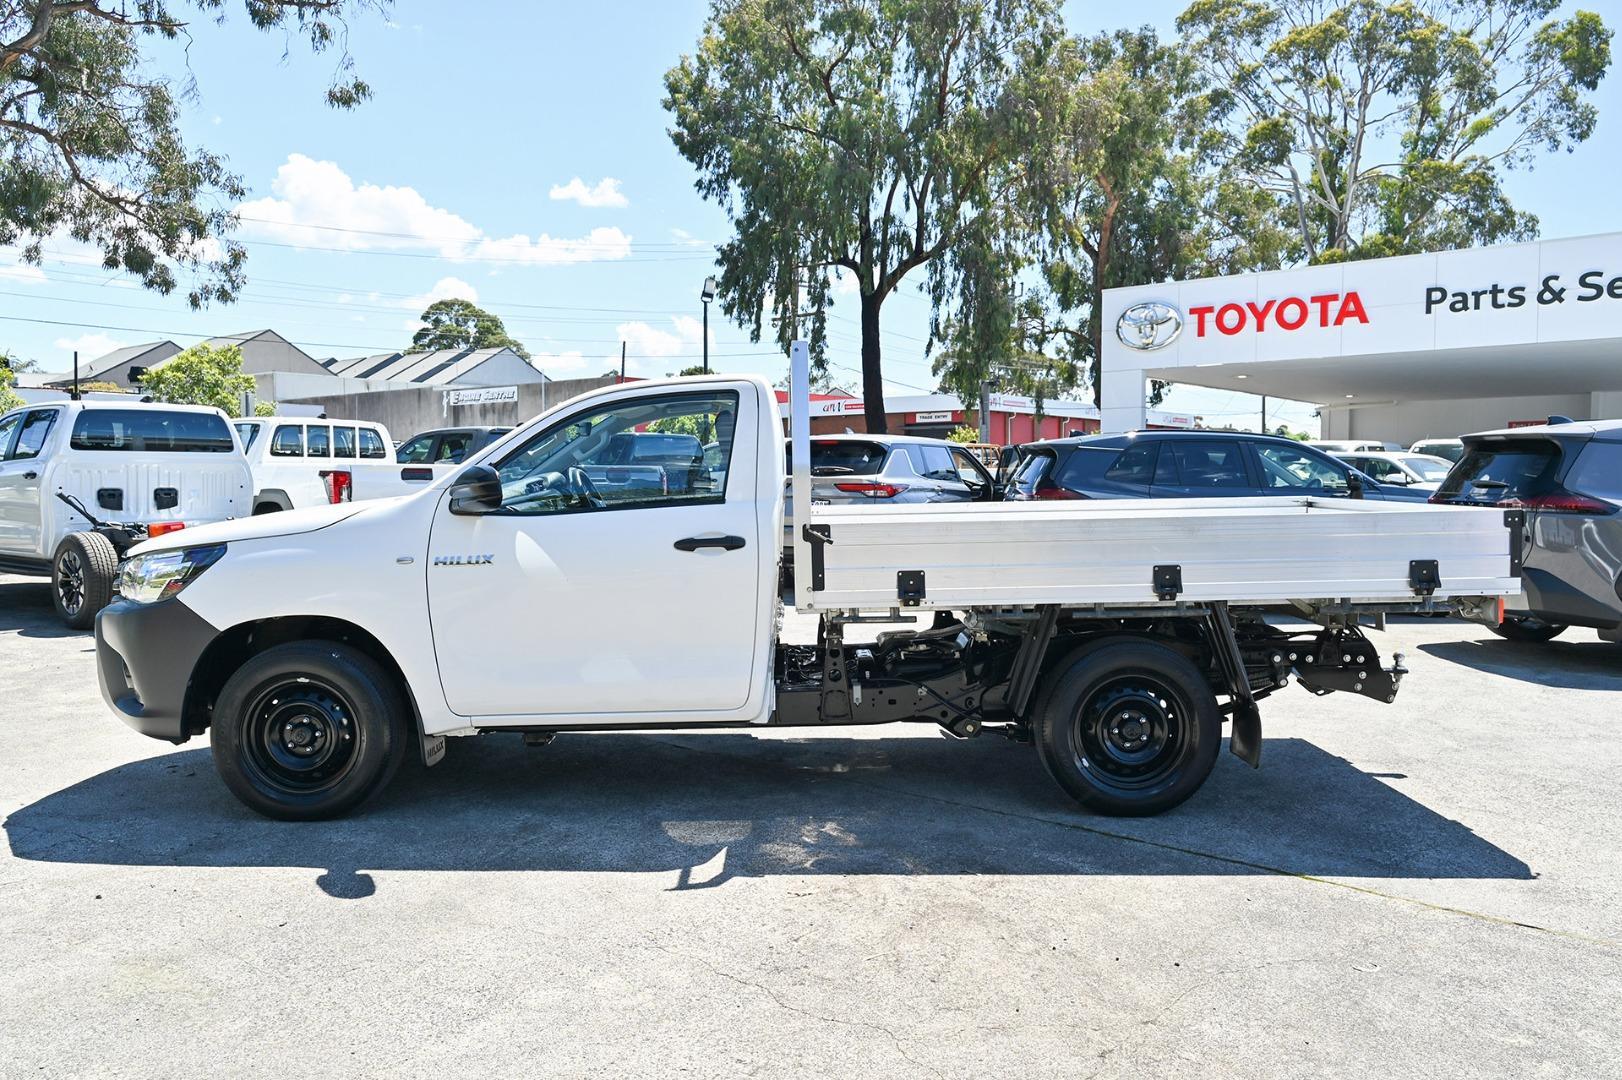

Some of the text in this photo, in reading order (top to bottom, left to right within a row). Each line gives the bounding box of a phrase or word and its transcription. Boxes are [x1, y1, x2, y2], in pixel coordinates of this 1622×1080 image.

[1425, 283, 1526, 314] Parts
[1536, 274, 1566, 305] &
[1189, 292, 1370, 338] TOYOTA
[433, 554, 495, 566] HILUX
